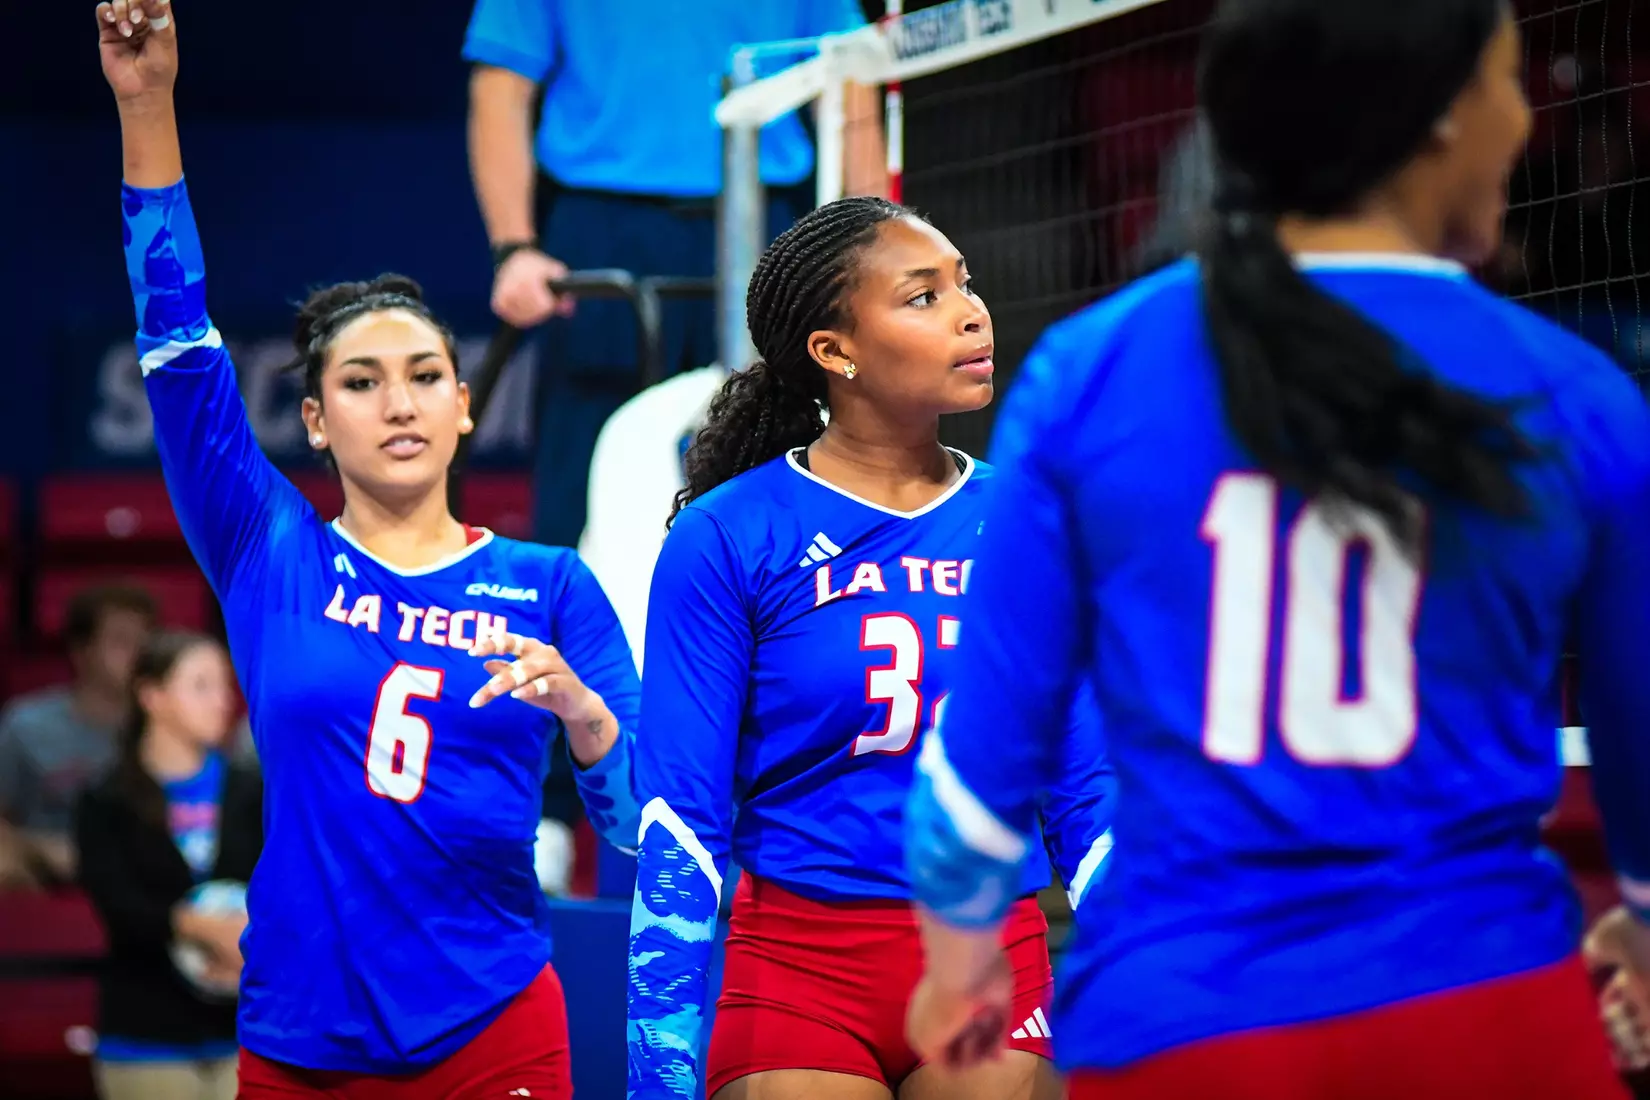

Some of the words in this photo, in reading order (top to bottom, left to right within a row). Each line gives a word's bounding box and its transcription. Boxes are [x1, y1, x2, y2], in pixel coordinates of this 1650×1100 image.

[324, 584, 382, 633] LA
[397, 601, 508, 655] TECH
[814, 562, 887, 606] LA
[1201, 471, 1425, 767] 10
[364, 660, 445, 804] 6
